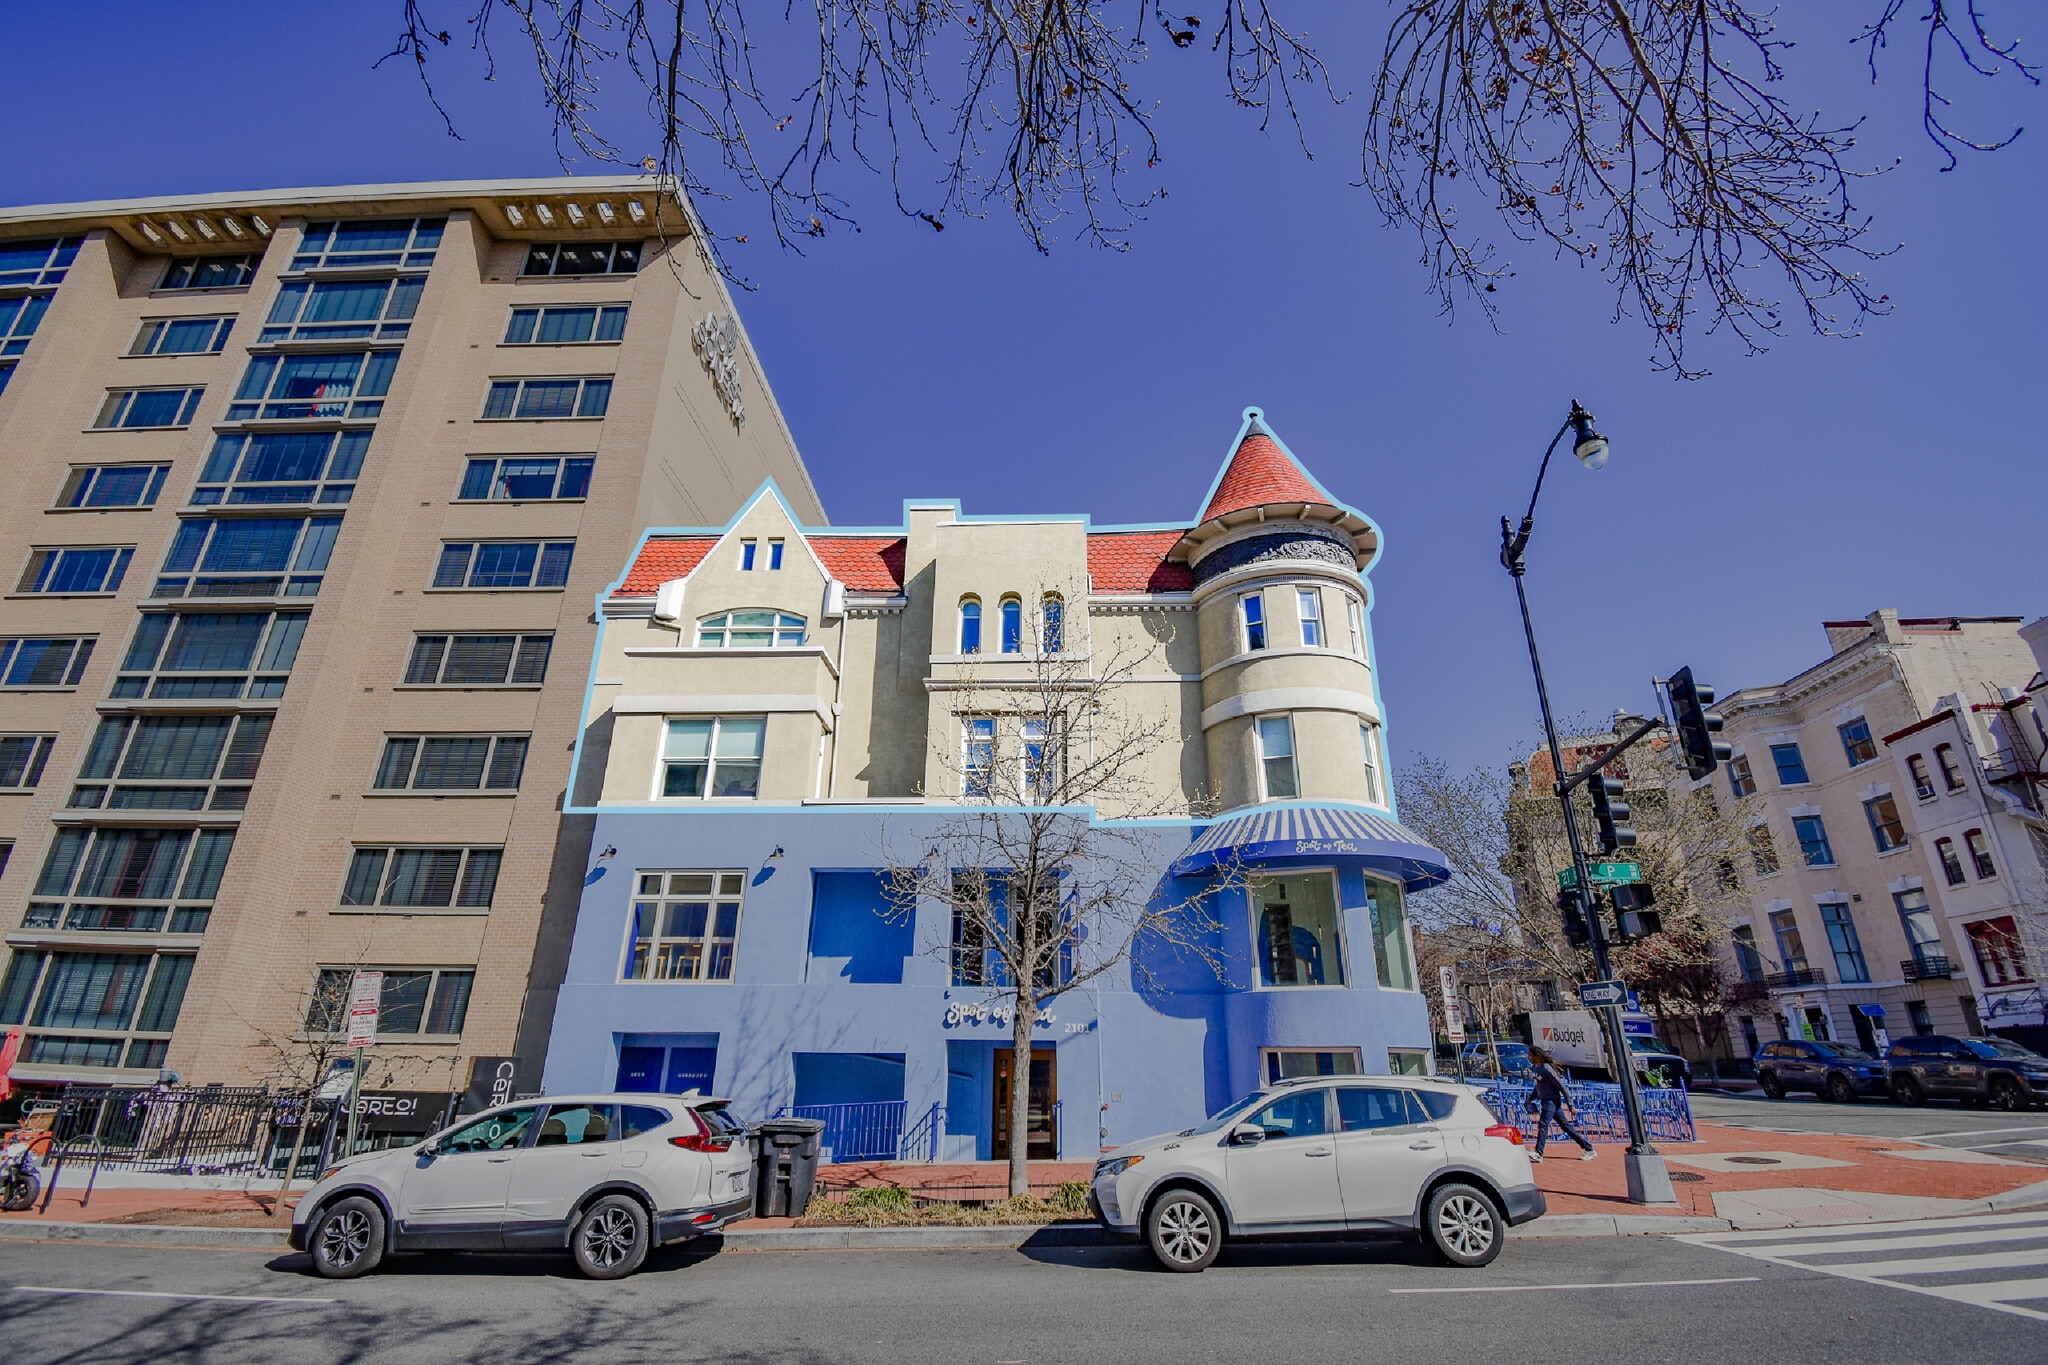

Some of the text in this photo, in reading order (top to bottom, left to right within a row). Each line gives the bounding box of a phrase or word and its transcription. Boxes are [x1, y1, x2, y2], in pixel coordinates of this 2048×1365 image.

[1296, 840, 1321, 853] Spot
[1333, 840, 1358, 853] Tea
[1607, 865, 1615, 878] P
[1585, 989, 1610, 999] ONE WAY
[947, 1001, 988, 1024] Spot
[993, 1003, 1013, 1024] of
[1064, 1023, 1090, 1033] 2101
[1553, 1028, 1585, 1047] Budget
